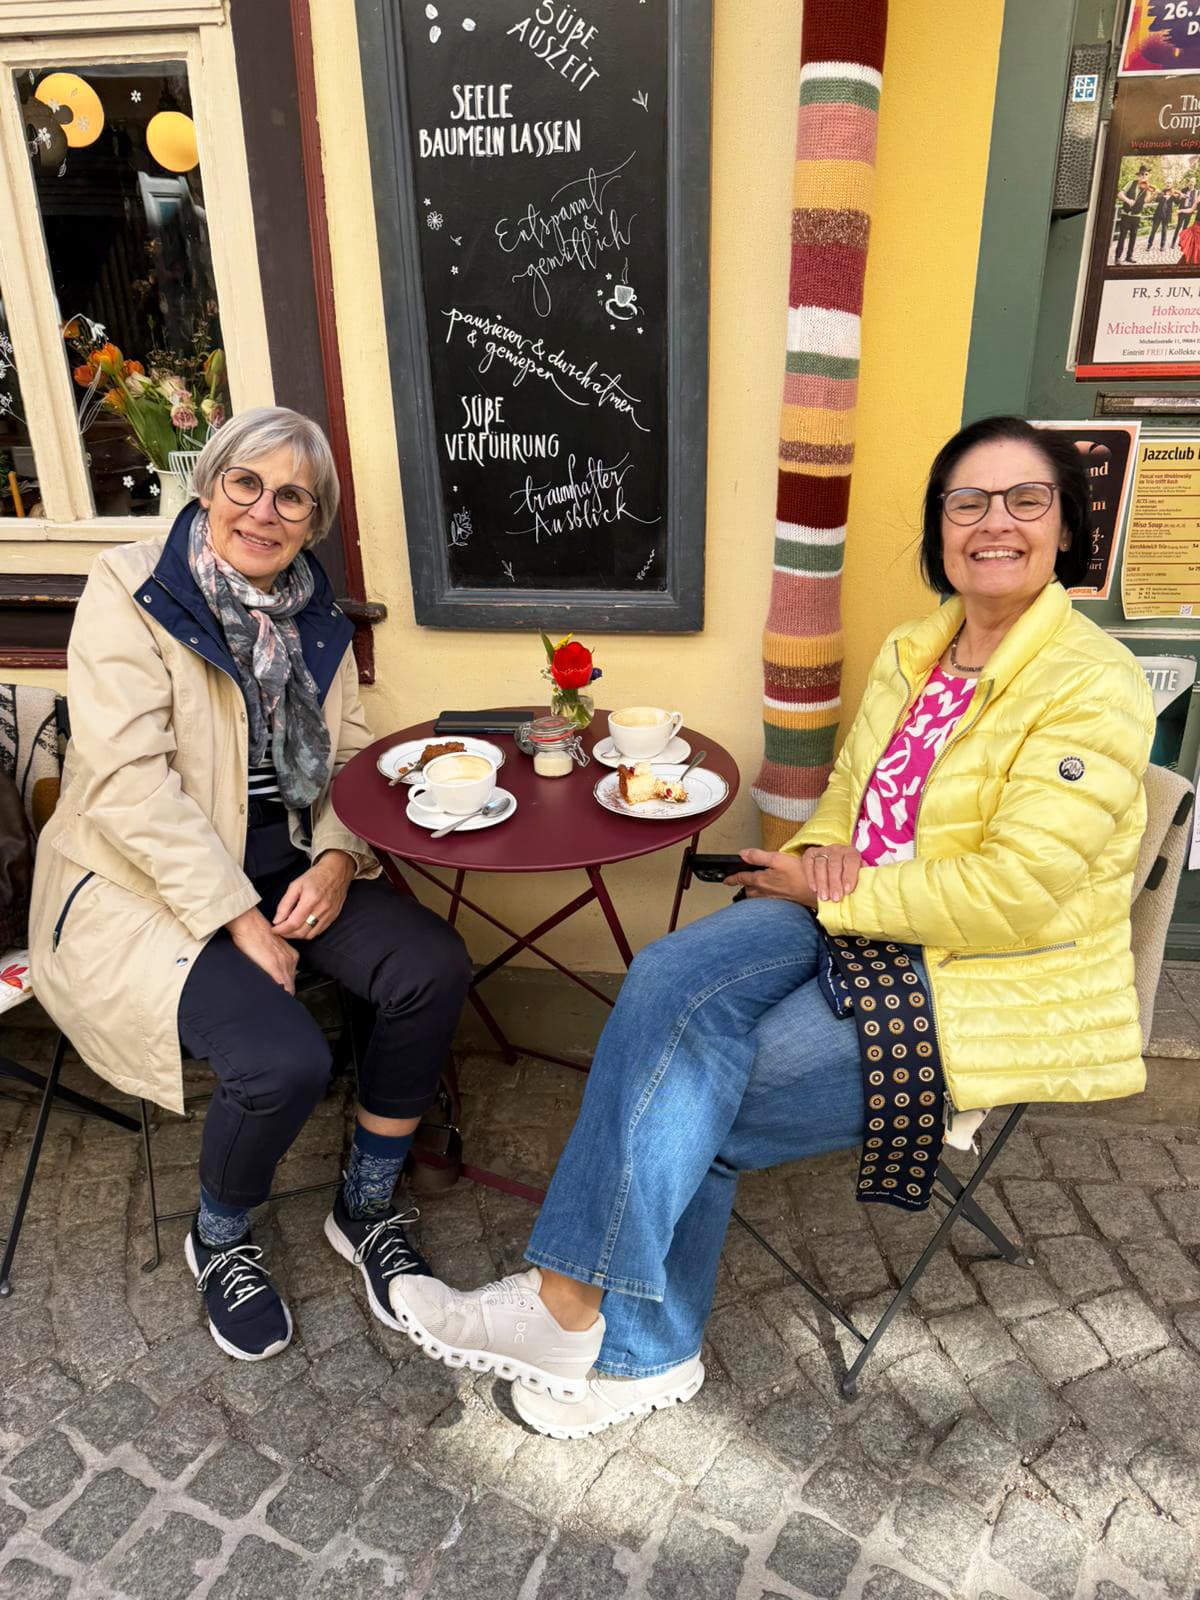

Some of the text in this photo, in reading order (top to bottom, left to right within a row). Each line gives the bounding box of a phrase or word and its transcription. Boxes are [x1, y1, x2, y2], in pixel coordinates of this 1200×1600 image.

[1162, 1, 1194, 21] 26.
[1187, 21, 1200, 36] D
[450, 84, 513, 121] SEELE
[419, 119, 582, 158] BAUMELN LASSEN
[584, 215, 598, 231] &
[1132, 287, 1151, 299] FR,
[1153, 287, 1164, 298] 5.
[1166, 286, 1193, 299] JUN,
[441, 307, 651, 432] pausieren & durchatmen
[466, 328, 591, 406] & genießen
[444, 432, 560, 468] VERFÜHRUNG
[1142, 446, 1195, 463] Jazzclub
[509, 452, 635, 515] traumhafter
[504, 487, 662, 545] Ausblick
